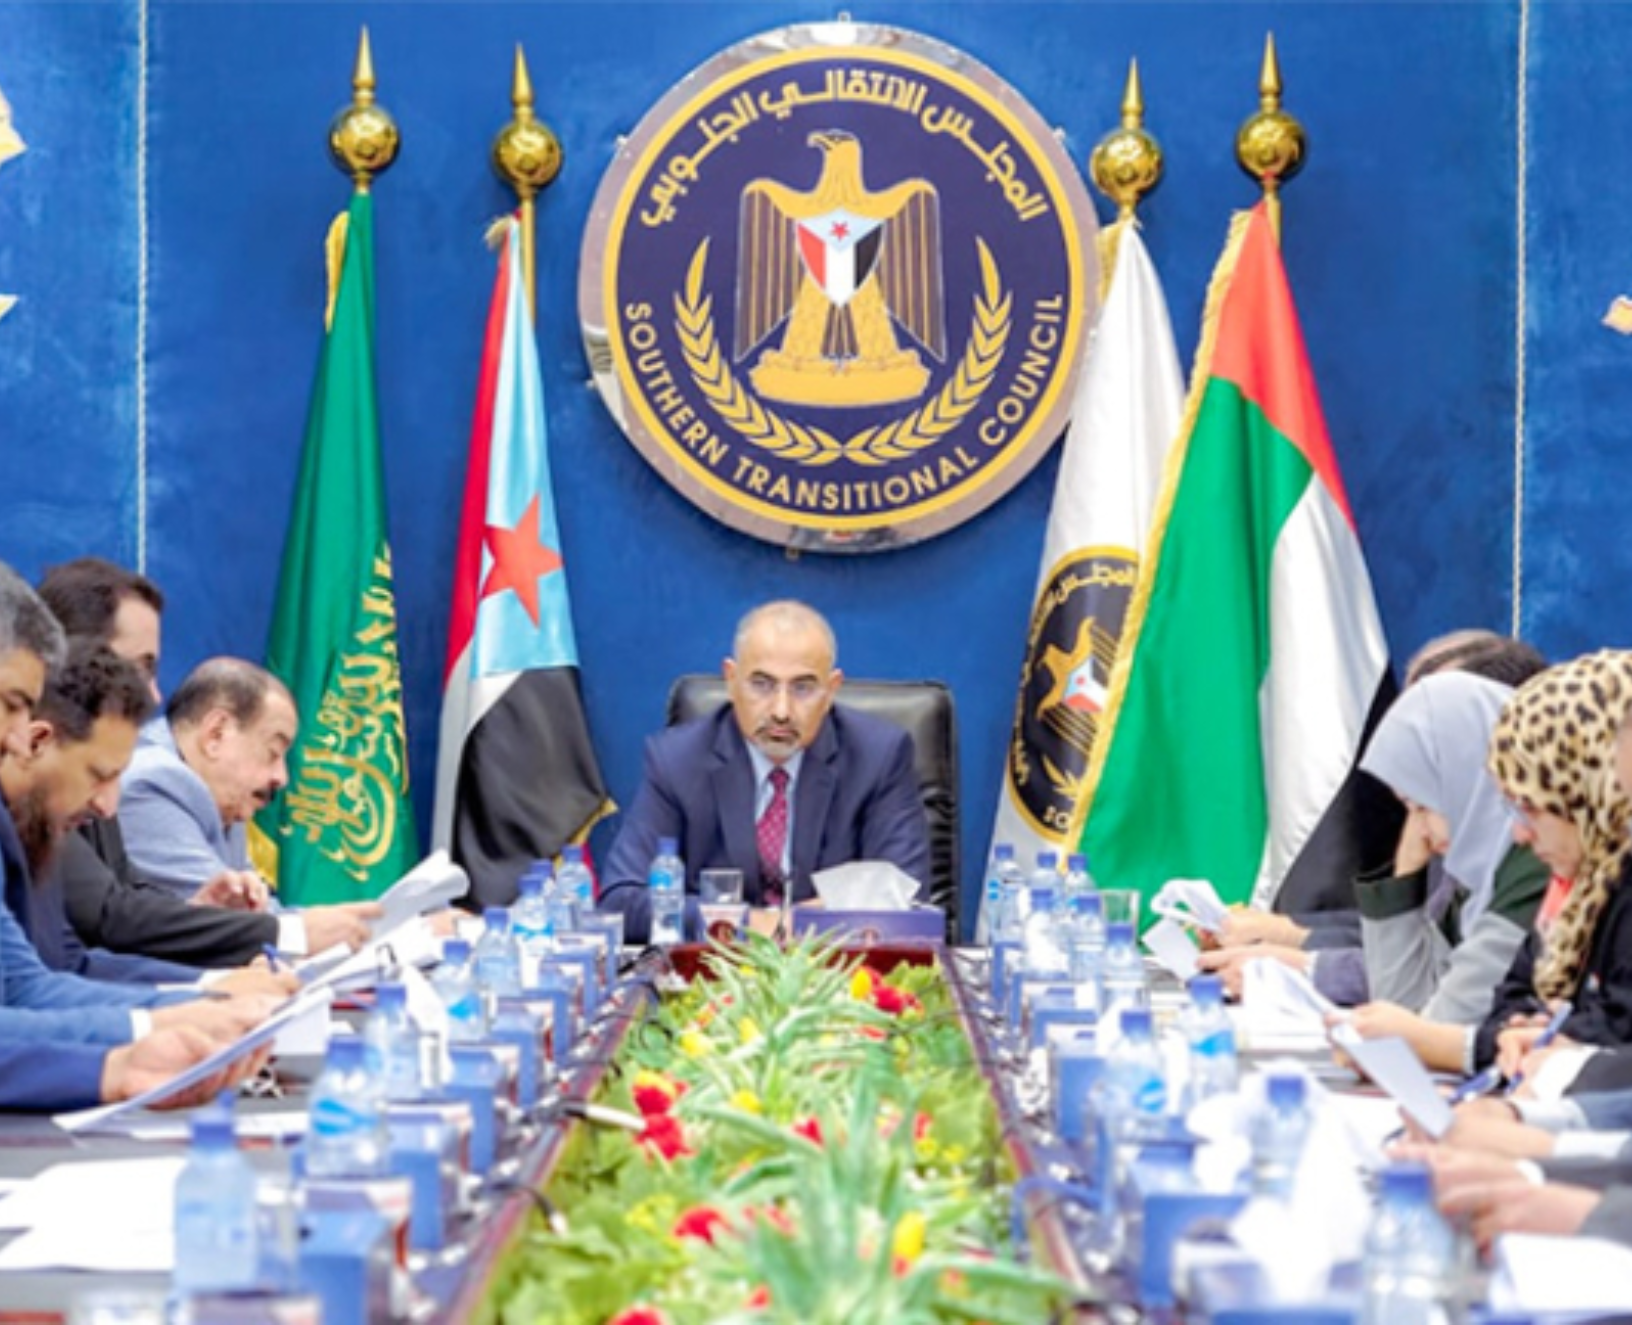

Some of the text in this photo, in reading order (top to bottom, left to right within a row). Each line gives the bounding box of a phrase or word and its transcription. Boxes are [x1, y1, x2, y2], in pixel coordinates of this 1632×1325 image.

[641, 69, 1048, 228] المجلس الانتقالي الجنوبي
[625, 294, 1063, 511] SOUTHERN TRANSITIONAL COUNCIL
